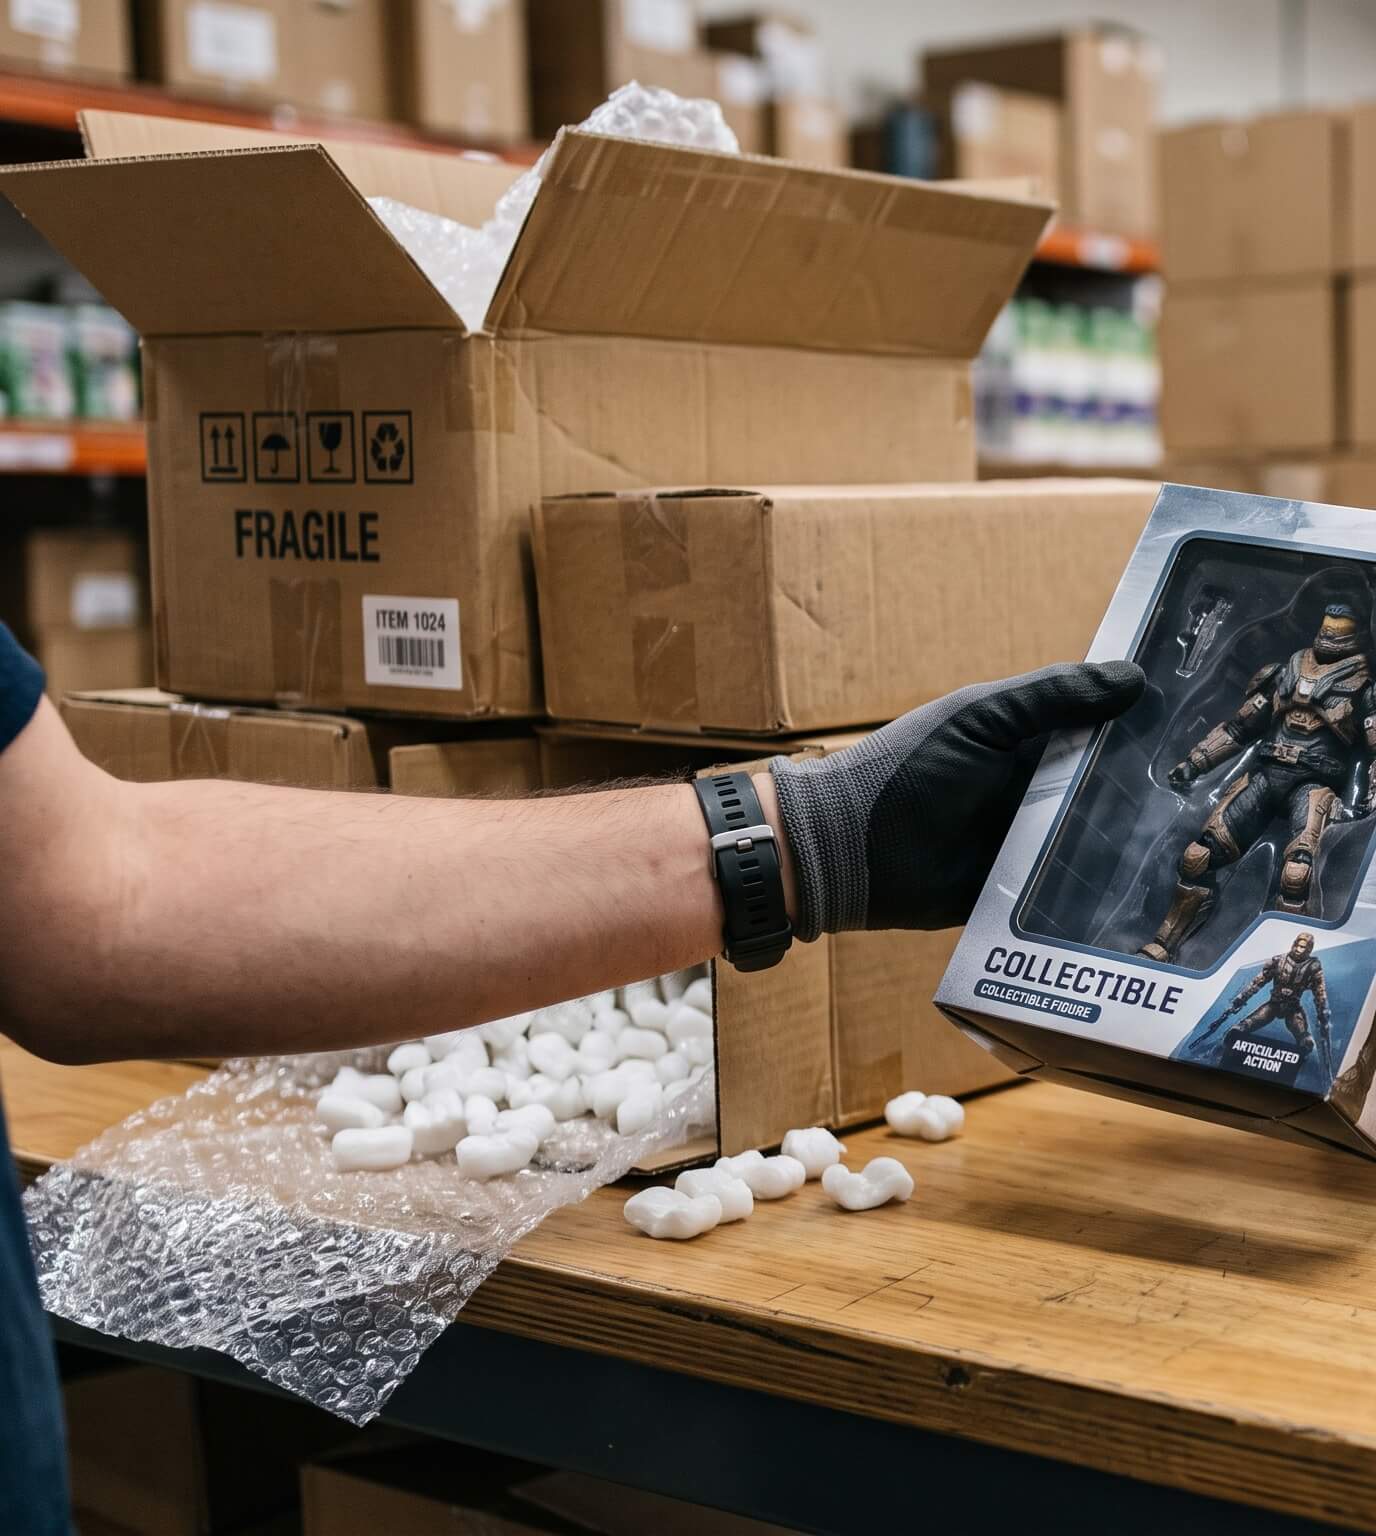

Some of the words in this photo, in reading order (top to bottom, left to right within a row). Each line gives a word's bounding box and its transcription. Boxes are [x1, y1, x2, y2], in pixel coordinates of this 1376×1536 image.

[234, 509, 381, 562] FRAGILE
[376, 609, 409, 630] ITEM
[414, 611, 446, 632] 1024
[984, 946, 1184, 1015] COLLECTIBLE
[979, 983, 1051, 1009] COLLECTIBLE
[1050, 999, 1093, 1018] FIGURE
[1232, 1039, 1300, 1064] ARTICULATED
[1243, 1054, 1282, 1073] ACTION
